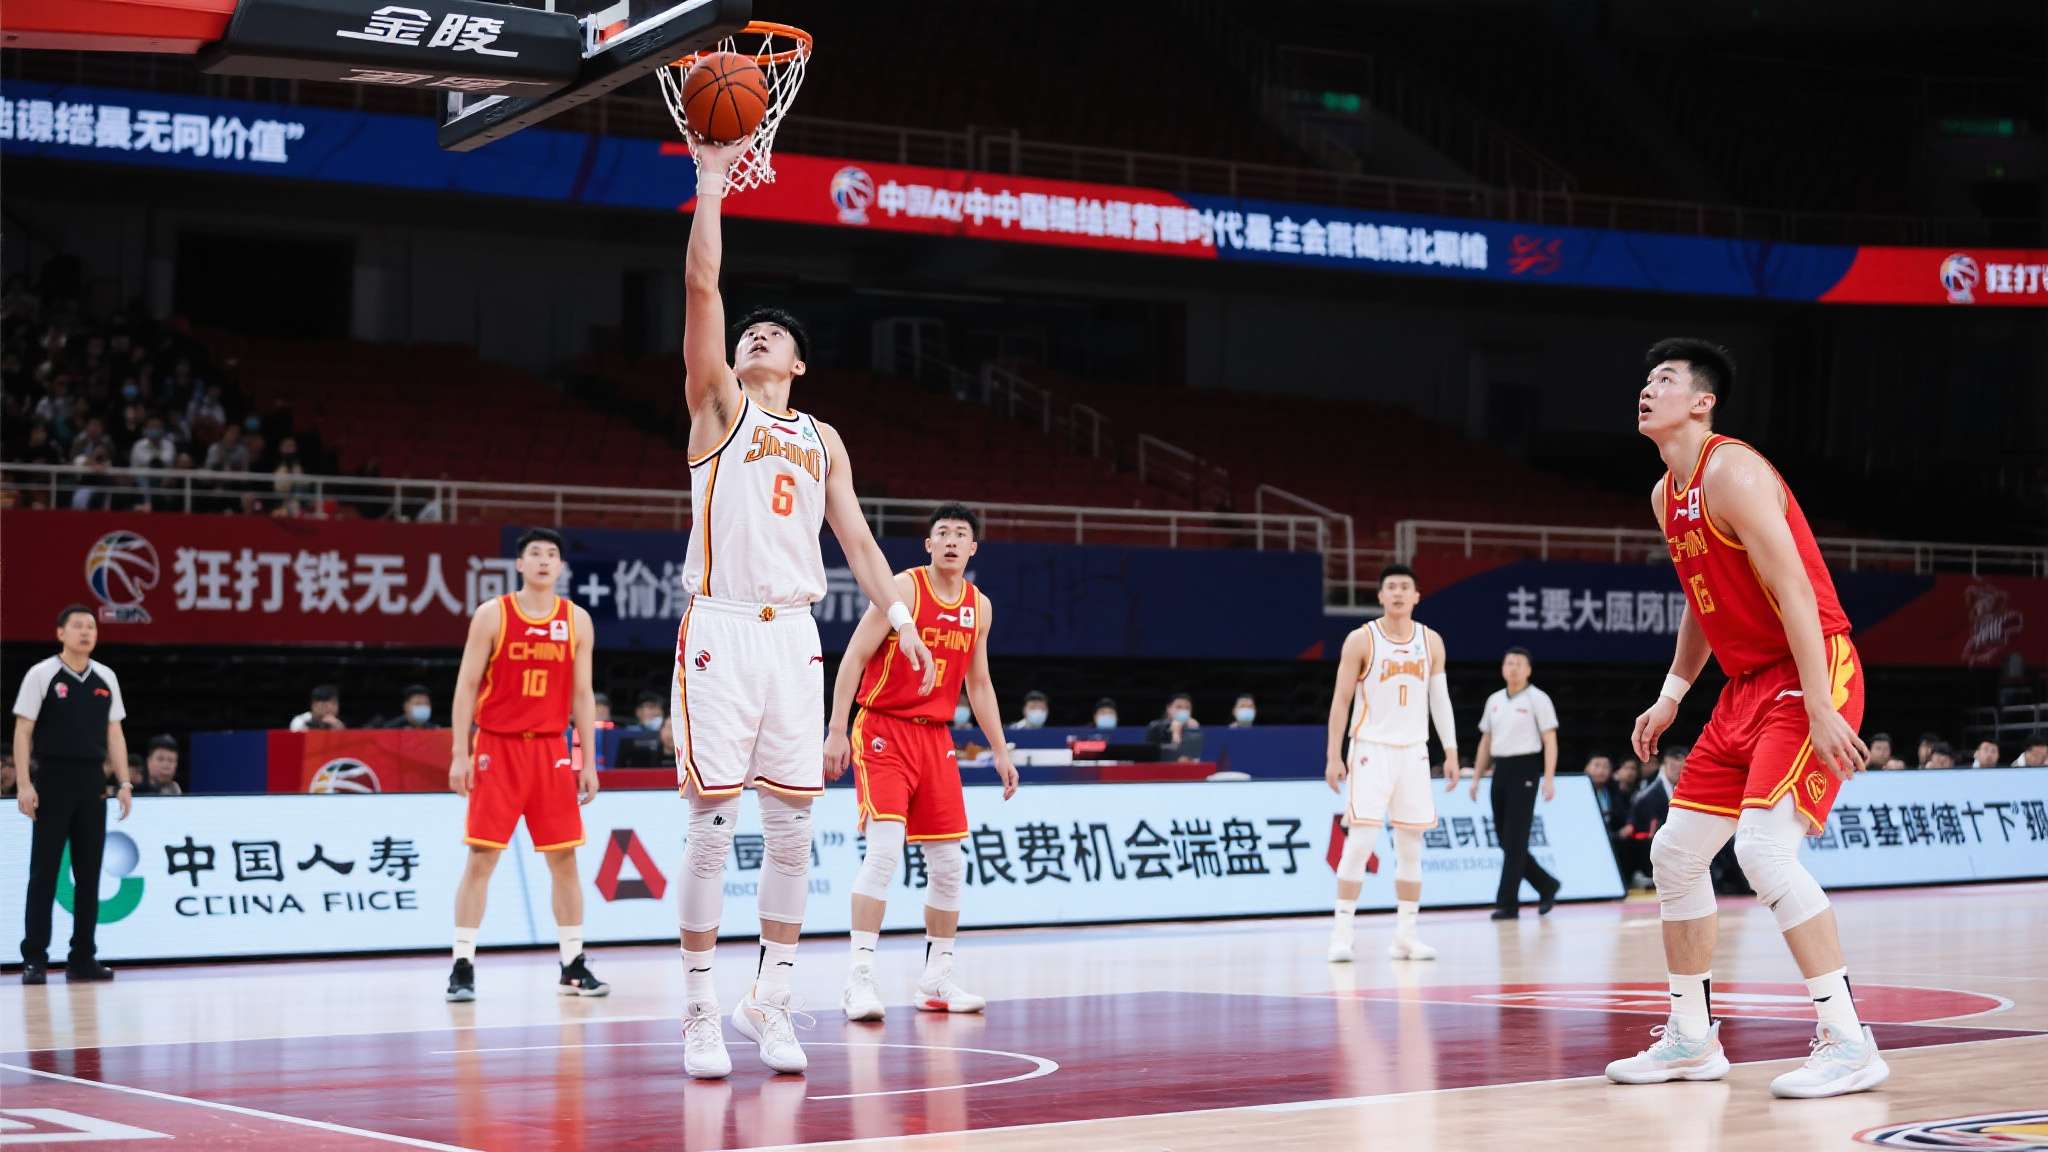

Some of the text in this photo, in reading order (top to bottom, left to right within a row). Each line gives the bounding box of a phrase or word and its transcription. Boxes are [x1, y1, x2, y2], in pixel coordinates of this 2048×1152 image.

[1985, 262, 2048, 294] 狂打
[522, 669, 549, 698] 10
[164, 835, 420, 887] 中国人寿
